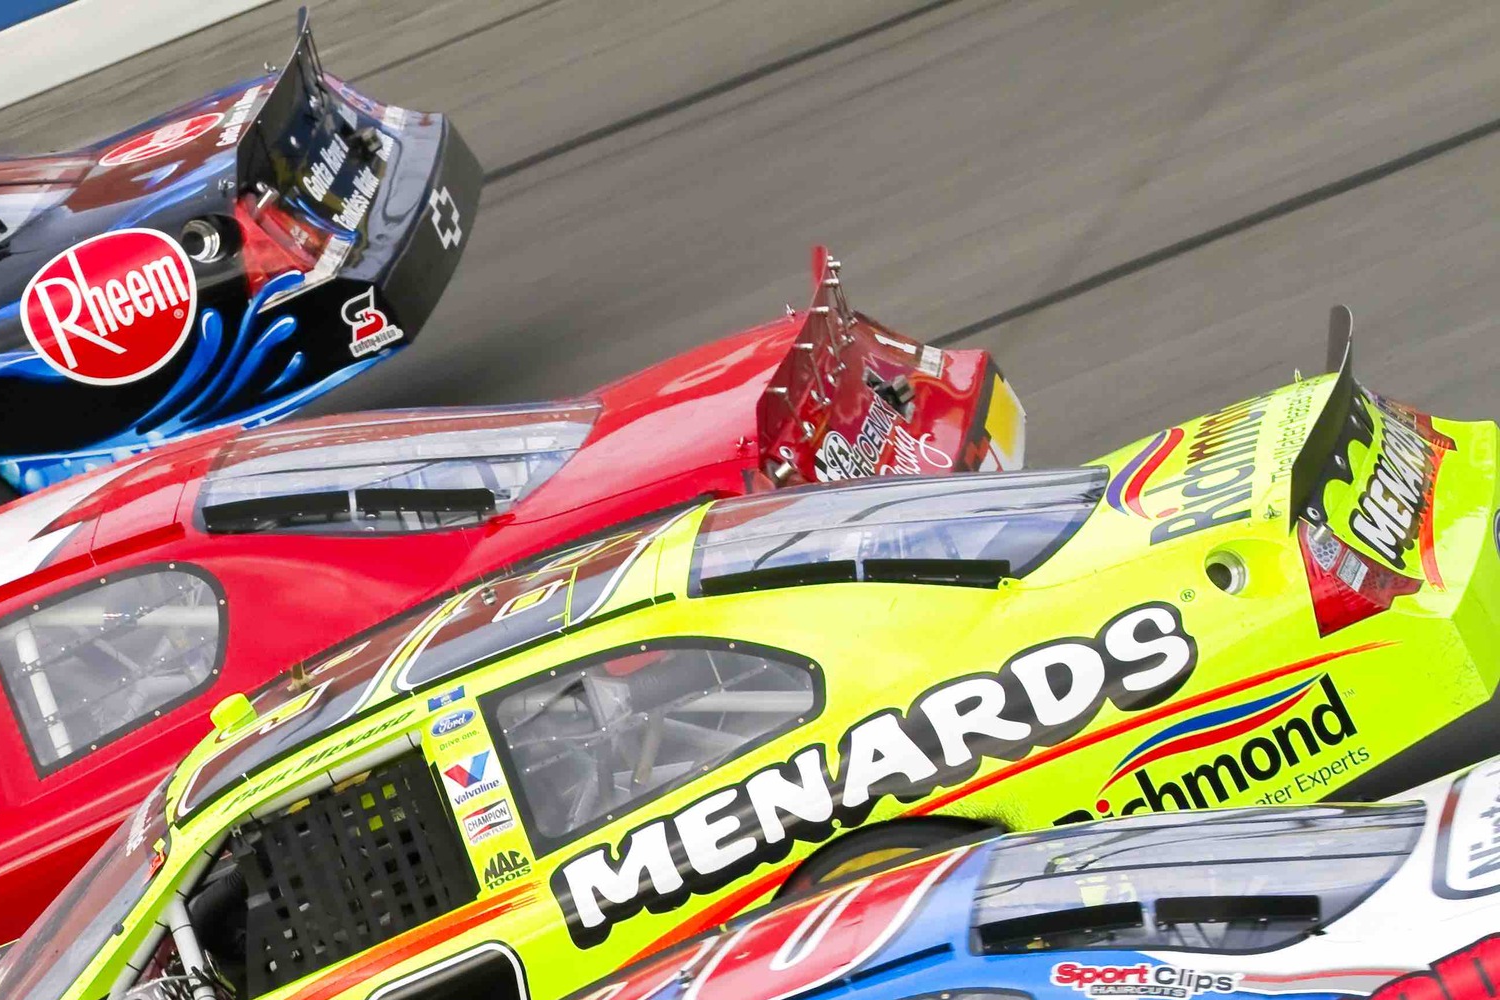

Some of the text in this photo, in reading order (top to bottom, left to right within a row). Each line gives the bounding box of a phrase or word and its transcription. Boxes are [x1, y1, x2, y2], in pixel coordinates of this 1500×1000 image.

[35, 250, 190, 370] Rheem
[875, 333, 917, 354] 1
[438, 714, 467, 733] Ford
[439, 729, 480, 752] Drive one.
[221, 710, 416, 814] PAUL MENARD
[552, 603, 1195, 945] MENARDS
[1294, 746, 1371, 795] Experts
[454, 779, 500, 806] Valvoline
[467, 806, 508, 833] CHAMPION
[484, 850, 530, 885] MAC
[486, 866, 532, 891] TOOLS
[1055, 962, 1232, 994] Sport Clips
[1091, 983, 1187, 998] HAIRCUTS
